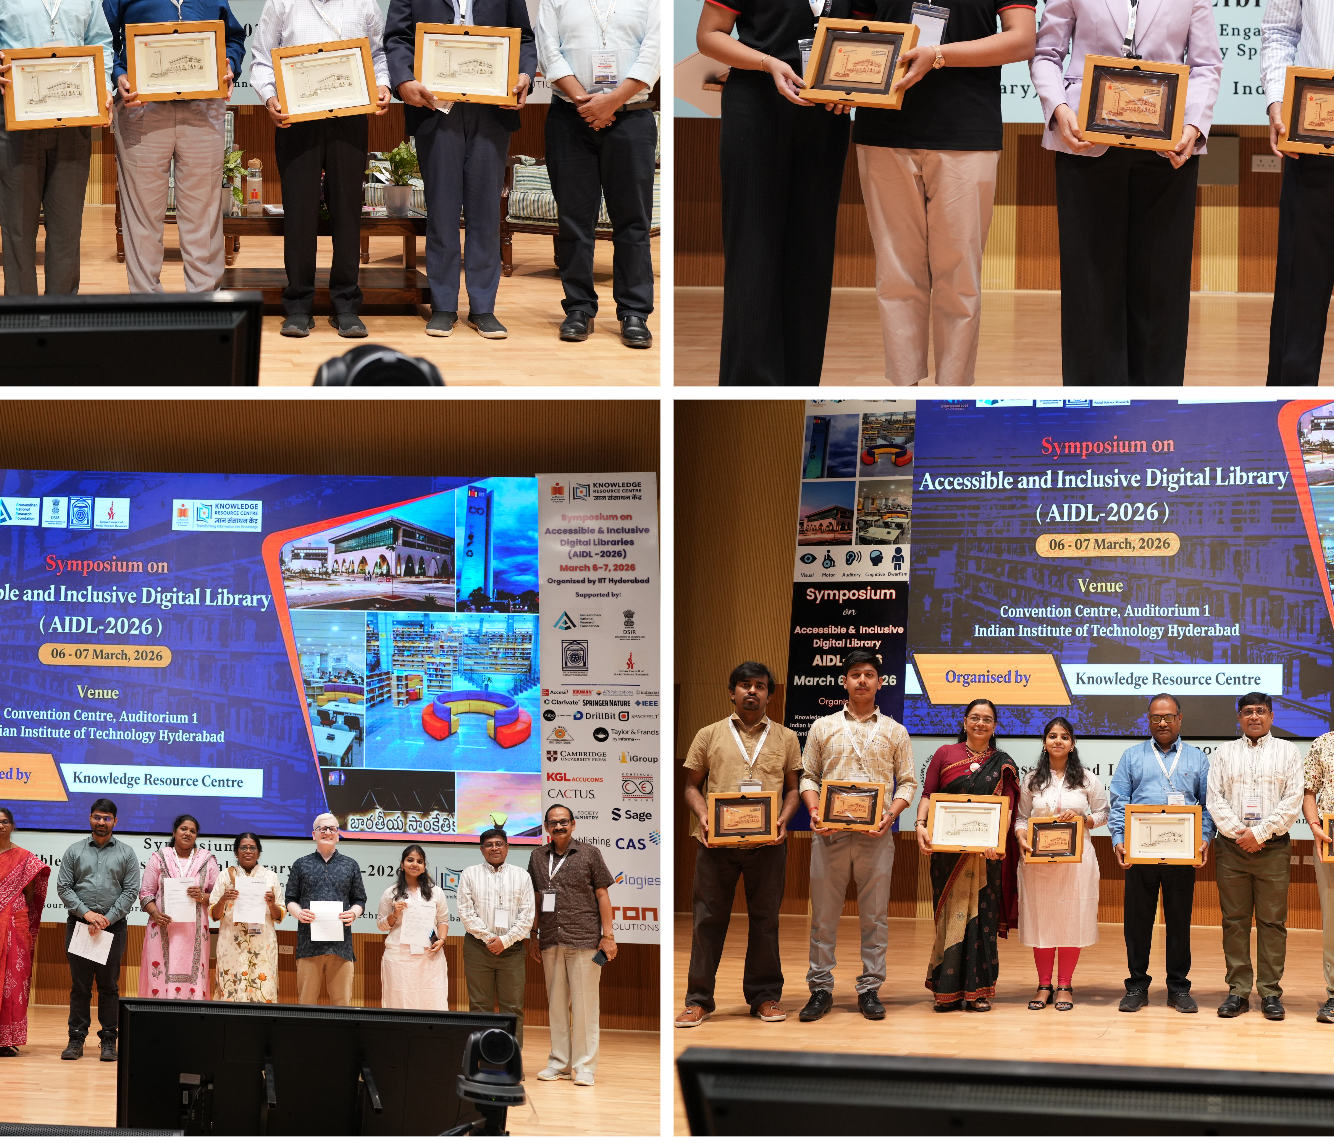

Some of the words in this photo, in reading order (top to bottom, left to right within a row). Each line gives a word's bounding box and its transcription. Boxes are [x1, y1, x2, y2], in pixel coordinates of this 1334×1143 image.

[919, 471, 1013, 492] Accessible
[1018, 471, 1053, 490] and
[1056, 470, 1140, 490] Inclusive
[1146, 468, 1211, 492] Digital
[1215, 466, 1289, 491] Library
[46, 555, 142, 577] Symposium
[146, 560, 169, 575] on
[806, 586, 896, 604] Symposium
[17, 768, 32, 783] by
[73, 772, 141, 790] Knowledge
[144, 773, 197, 788] Resource
[201, 774, 244, 789] Centre
[625, 810, 652, 822] Sage
